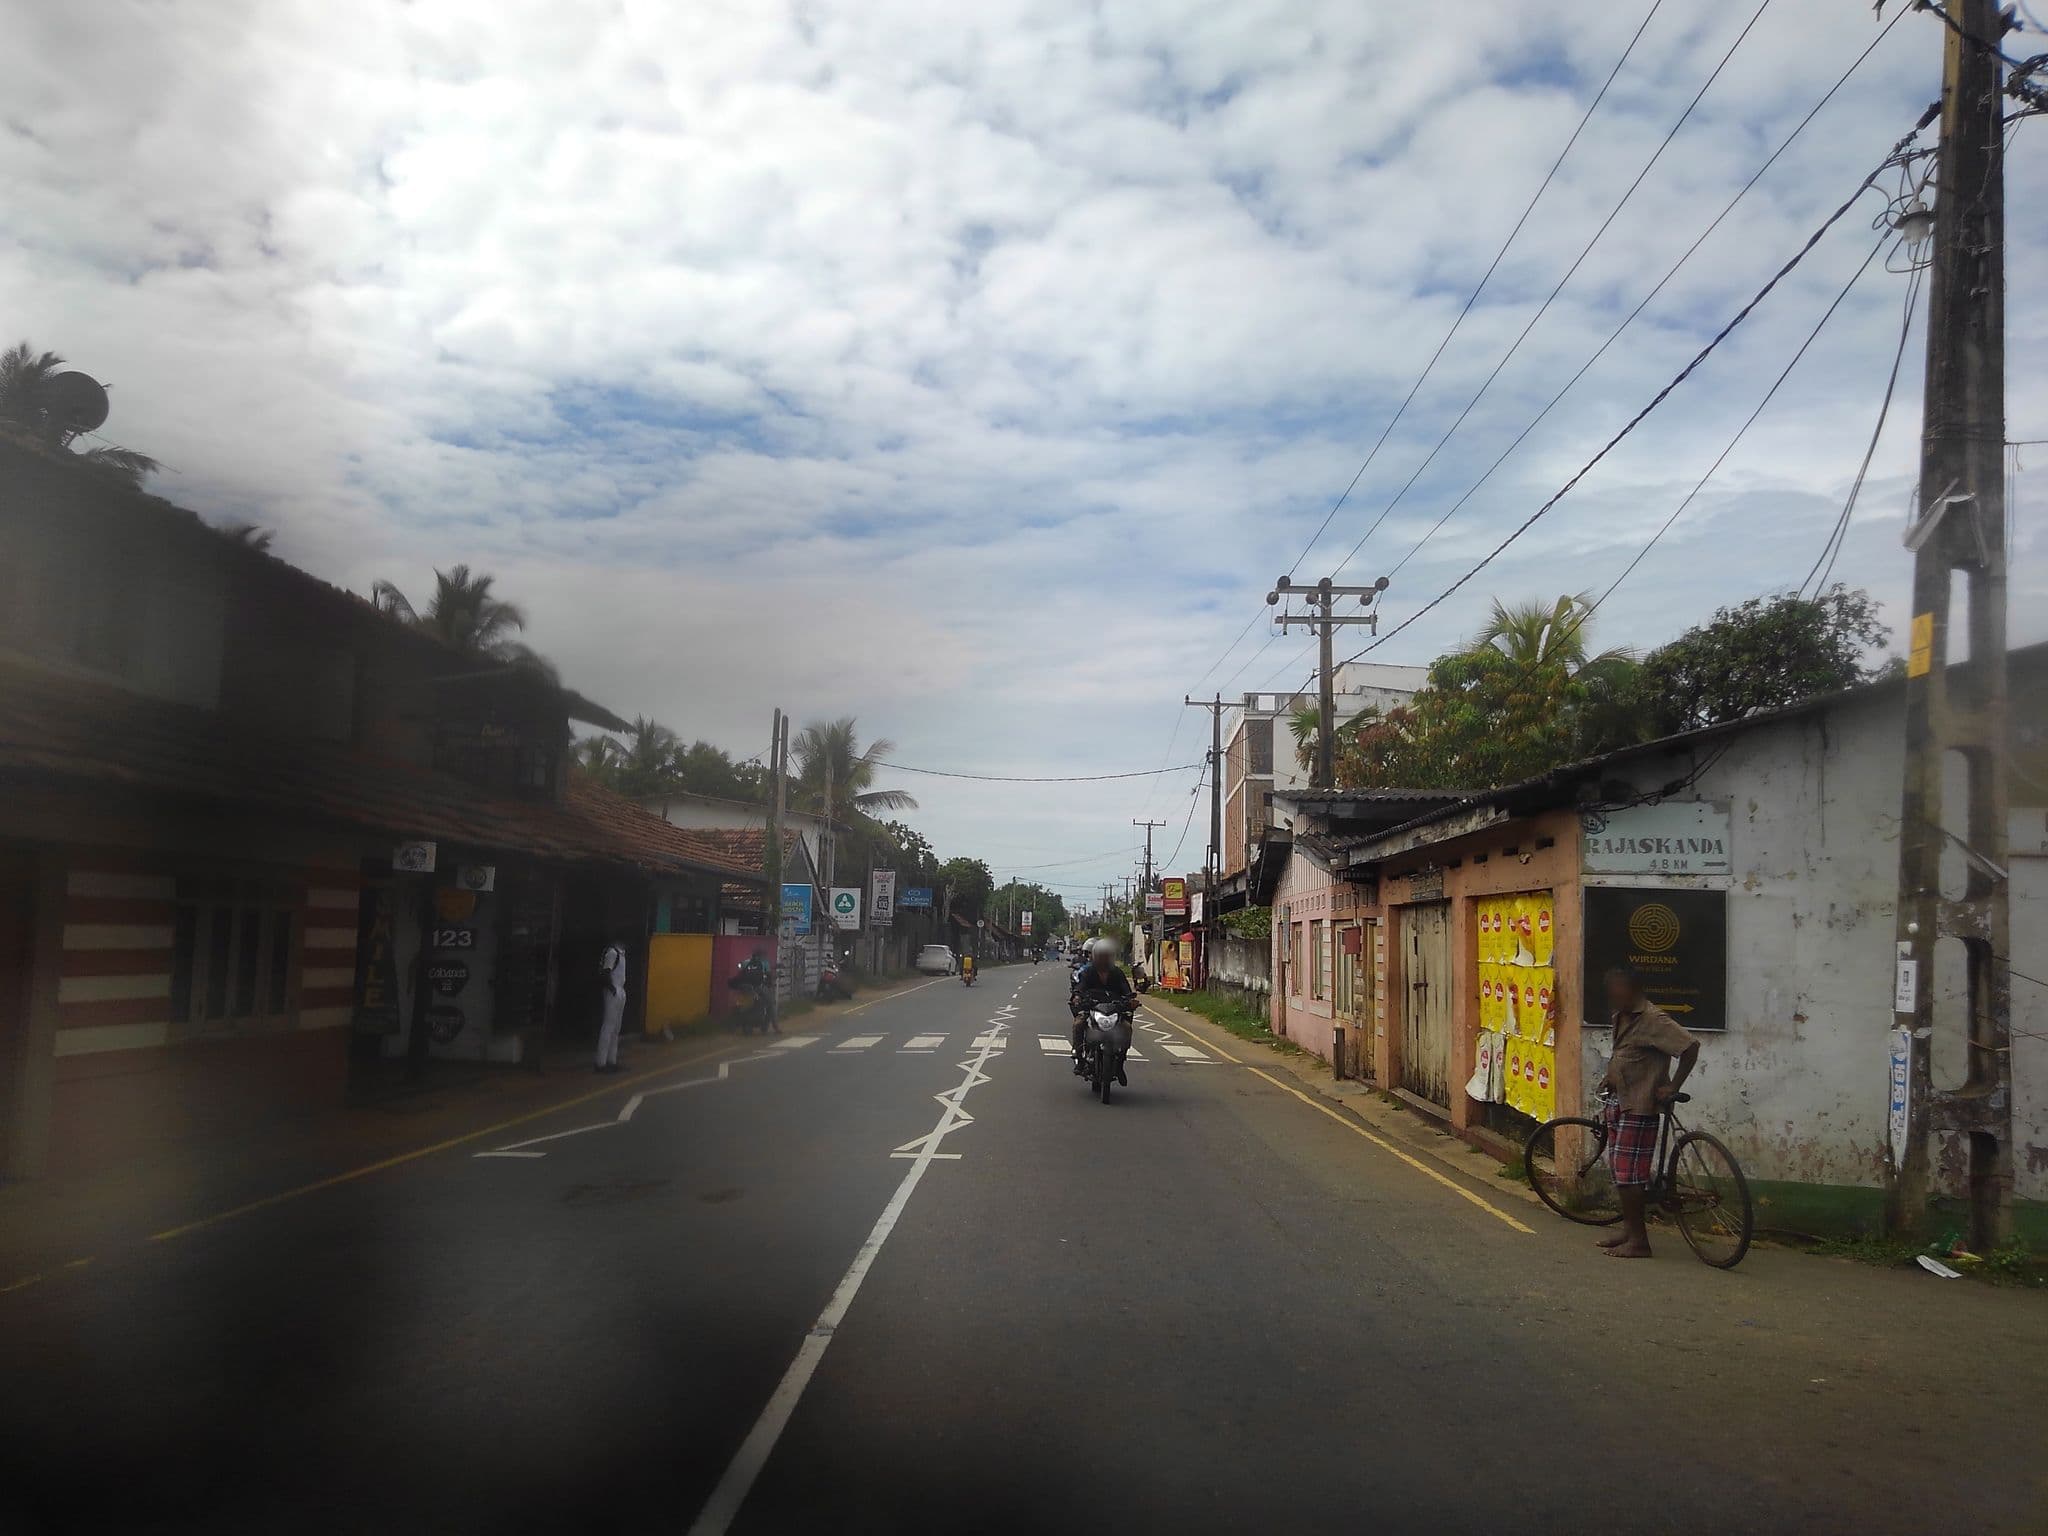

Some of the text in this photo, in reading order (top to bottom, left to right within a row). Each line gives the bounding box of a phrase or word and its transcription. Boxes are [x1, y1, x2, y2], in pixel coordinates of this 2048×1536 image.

[1586, 838, 1724, 855] RAJASKANDA
[1674, 859, 1688, 869] KM
[431, 929, 472, 947] 123
[1629, 955, 1678, 965] WIRDANA
